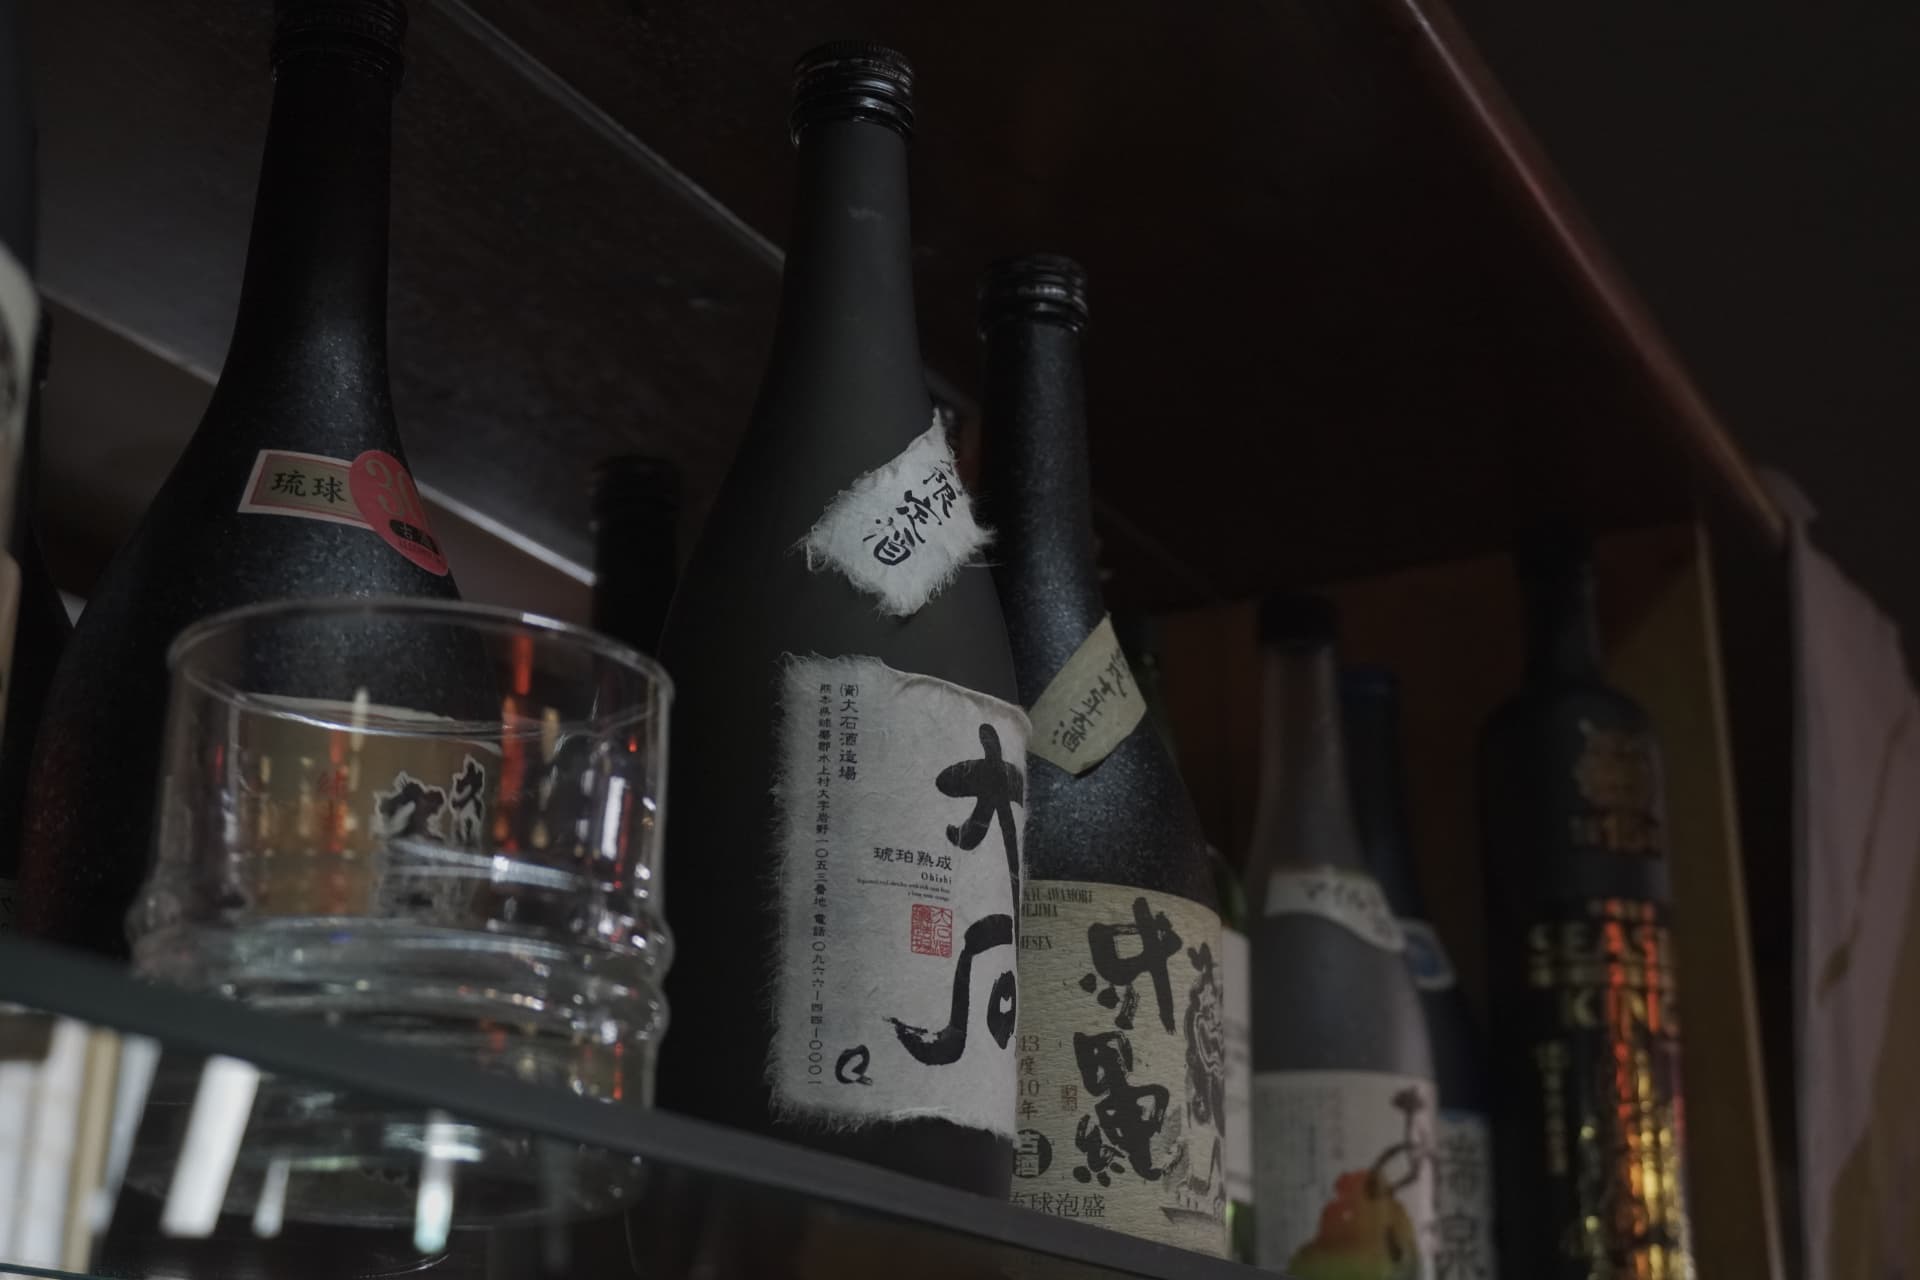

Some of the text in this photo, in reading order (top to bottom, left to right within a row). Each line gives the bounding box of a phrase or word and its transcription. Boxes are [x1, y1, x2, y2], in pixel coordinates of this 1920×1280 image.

[270, 470, 346, 504] 琉球
[861, 460, 958, 566] 限定酒
[873, 847, 953, 871] 琥珀熟成
